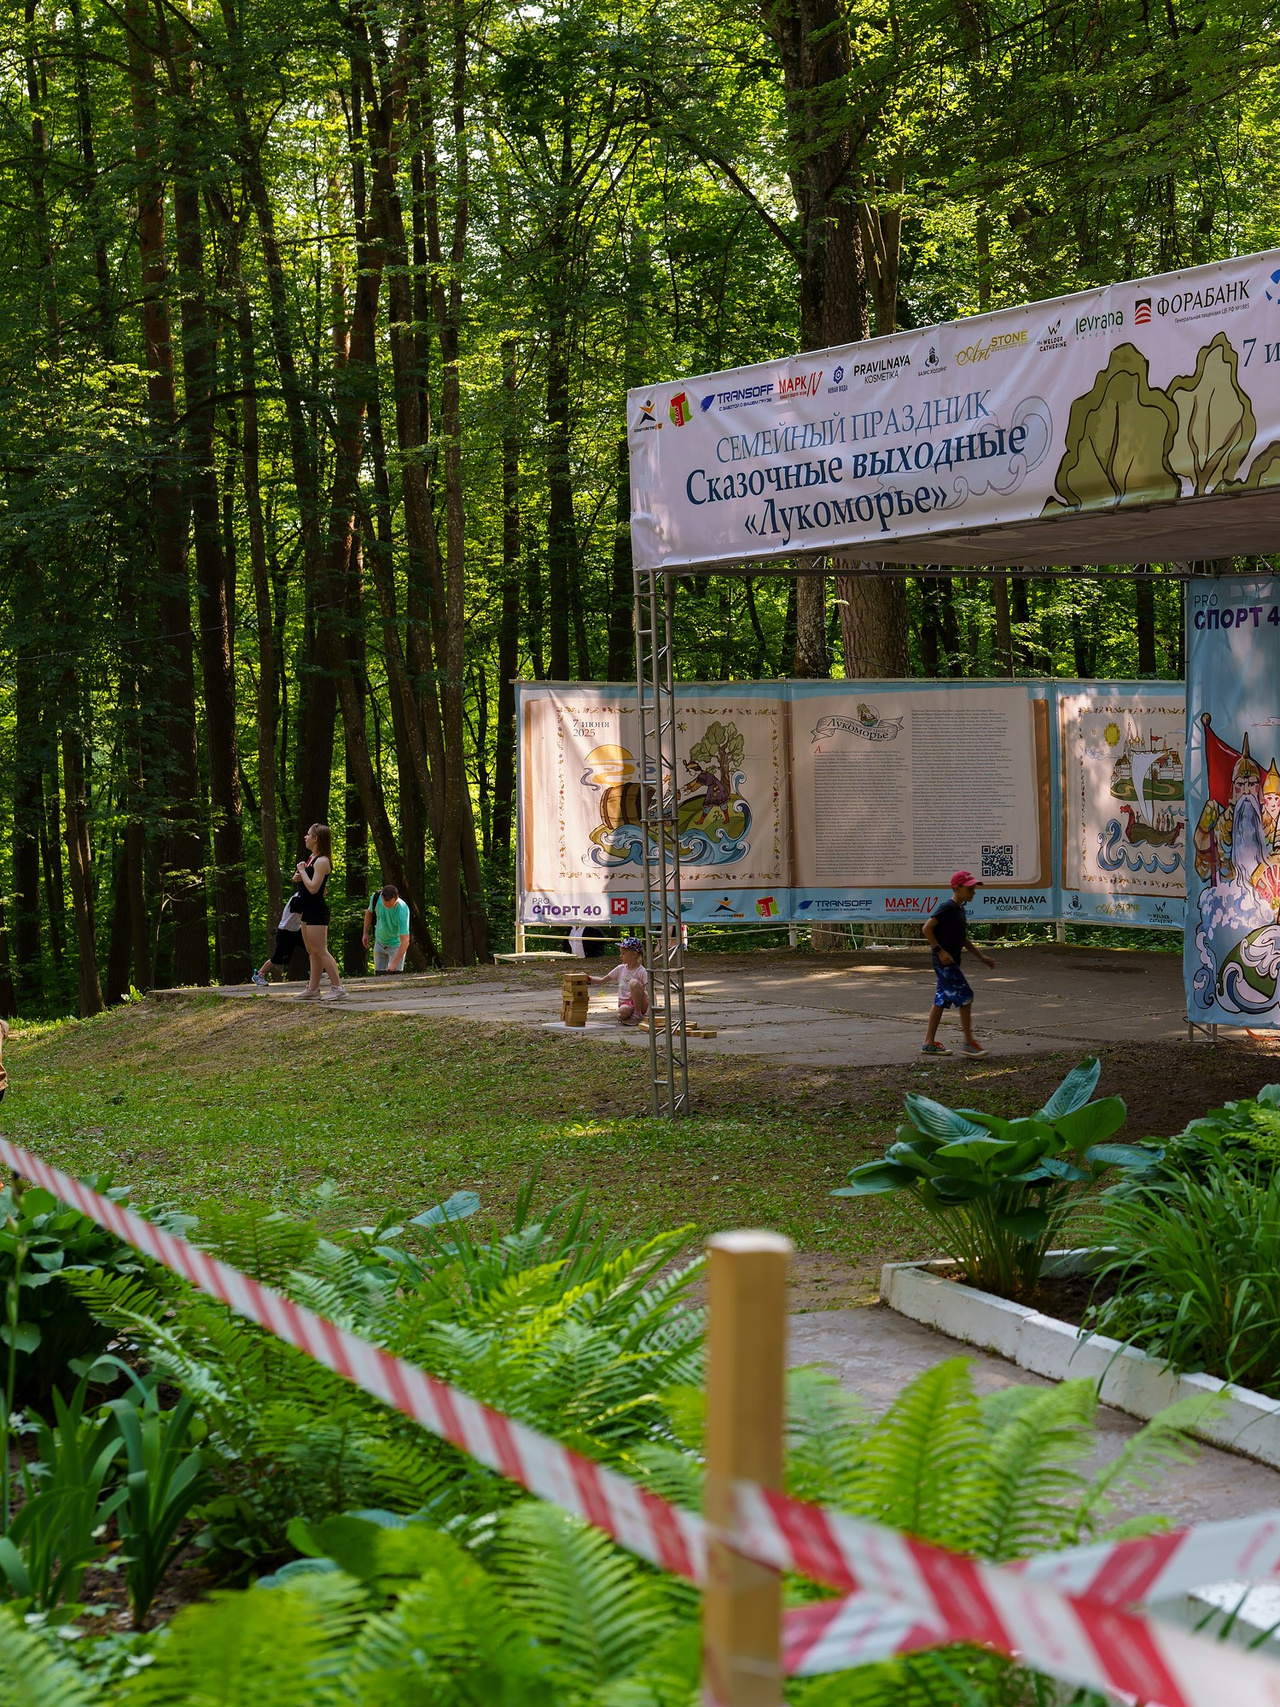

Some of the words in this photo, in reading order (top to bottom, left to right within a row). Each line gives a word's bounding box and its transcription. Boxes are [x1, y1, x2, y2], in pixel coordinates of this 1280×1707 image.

[1157, 279, 1250, 317] ФОРАБАНК
[1075, 311, 1124, 335] levrana
[990, 330, 1028, 348] STONE
[1039, 341, 1067, 352] CATHERINE
[1043, 336, 1063, 345] WELDER
[1242, 338, 1257, 367] 7
[853, 354, 911, 377] PRAVILNAYA
[864, 370, 899, 384] KOSMETIKA
[717, 383, 774, 405] TRANSOFF
[716, 411, 845, 464] СЕМЕЙНЫЙ
[852, 389, 992, 442] ПРАЗДНИК
[686, 454, 844, 506] Сказочные
[852, 424, 1027, 480] выходные
[744, 482, 948, 547] «Лукоморье»
[1194, 593, 1219, 608] PRO
[1194, 606, 1263, 630] СПОРТ
[572, 718, 579, 728] 7
[826, 717, 889, 741] Лукоморье
[573, 728, 596, 738] 2025
[532, 897, 550, 905] PRO
[983, 895, 1047, 905] PRAVILNAYA
[996, 904, 1035, 912] KOSMETIKA
[1117, 902, 1141, 911] STONE
[532, 904, 580, 916] СПОРТ
[583, 905, 602, 916] 40
